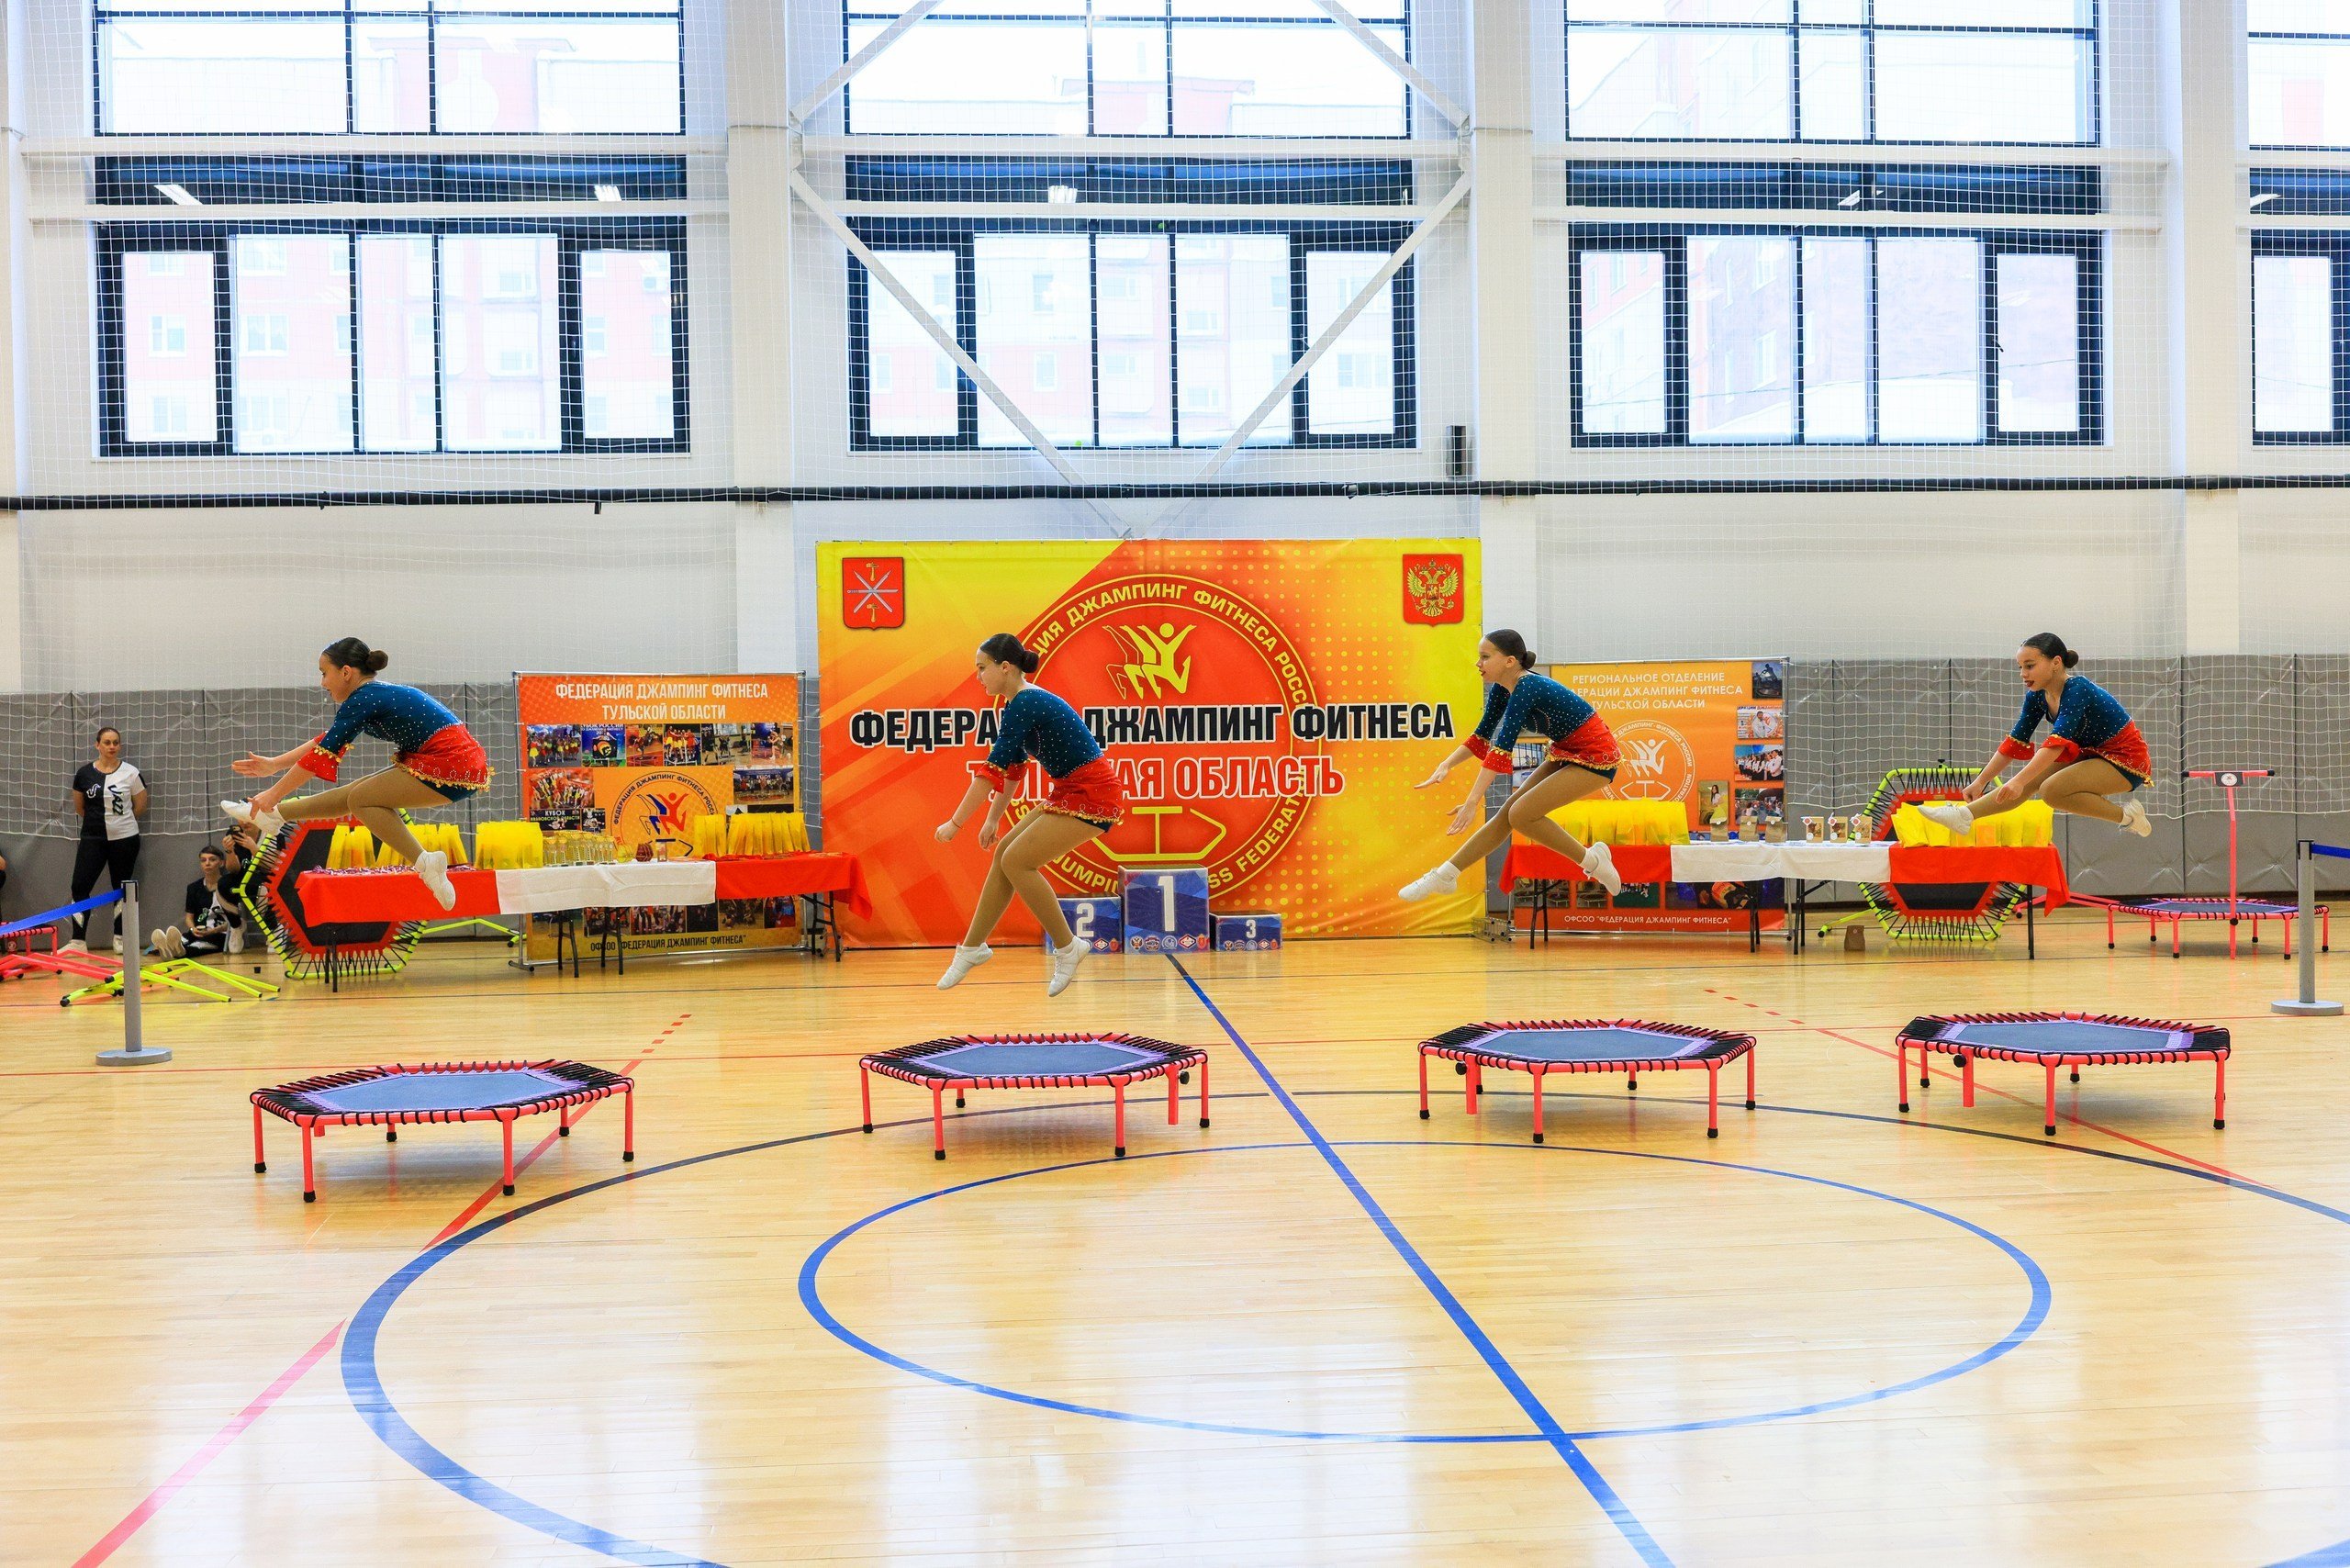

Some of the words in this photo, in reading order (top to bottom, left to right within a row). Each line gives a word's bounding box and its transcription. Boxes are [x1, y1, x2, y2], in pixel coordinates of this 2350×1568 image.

[1066, 582, 1187, 627] ДЖАМПИНГ
[1192, 589, 1278, 652] ФИТНЕСА
[1274, 651, 1308, 708] РОСС
[1572, 674, 1658, 684] РЕГИОНАЛЬНОЕ
[1661, 672, 1725, 684] ОТДЕЛЕНИЕ
[555, 683, 633, 700] ФЕДЕРАЦИЯ
[636, 683, 709, 700] ДЖАМПИНГ
[711, 683, 768, 699] ФИТНЕСА
[1572, 687, 1620, 698] ЕРАЦИИ
[1622, 687, 1688, 698] ДЖАМПИНГ
[1691, 685, 1743, 695] ФИТНЕСА
[601, 702, 667, 721] ТУЛЬСКОЙ
[670, 703, 726, 720] ОБЛАСТИ
[1652, 698, 1706, 709] ОБЛАСТИ
[851, 708, 1006, 754] ФЕДЕРА
[1083, 703, 1283, 751] ДЖАМПИНГ
[1292, 702, 1455, 743] ФИТНЕСА
[1680, 742, 1693, 767] РОССИИ
[1174, 756, 1346, 800] ОБЛАСТЬ
[1673, 774, 1693, 801] DERATION
[613, 785, 636, 825] ФЕДЕРАЦИЯ
[635, 774, 675, 788] ДЖАМПИНГ
[677, 776, 704, 797] ФИТНЕСА
[1158, 875, 1176, 932] 1
[1076, 902, 1094, 937] 2
[1246, 919, 1257, 939] 3
[1564, 914, 1595, 924] ОФСОО
[1646, 915, 1691, 924] ДЖАМПИНГ
[590, 941, 616, 952] ОФОО
[666, 936, 709, 948] ДЖАМПИНГ
